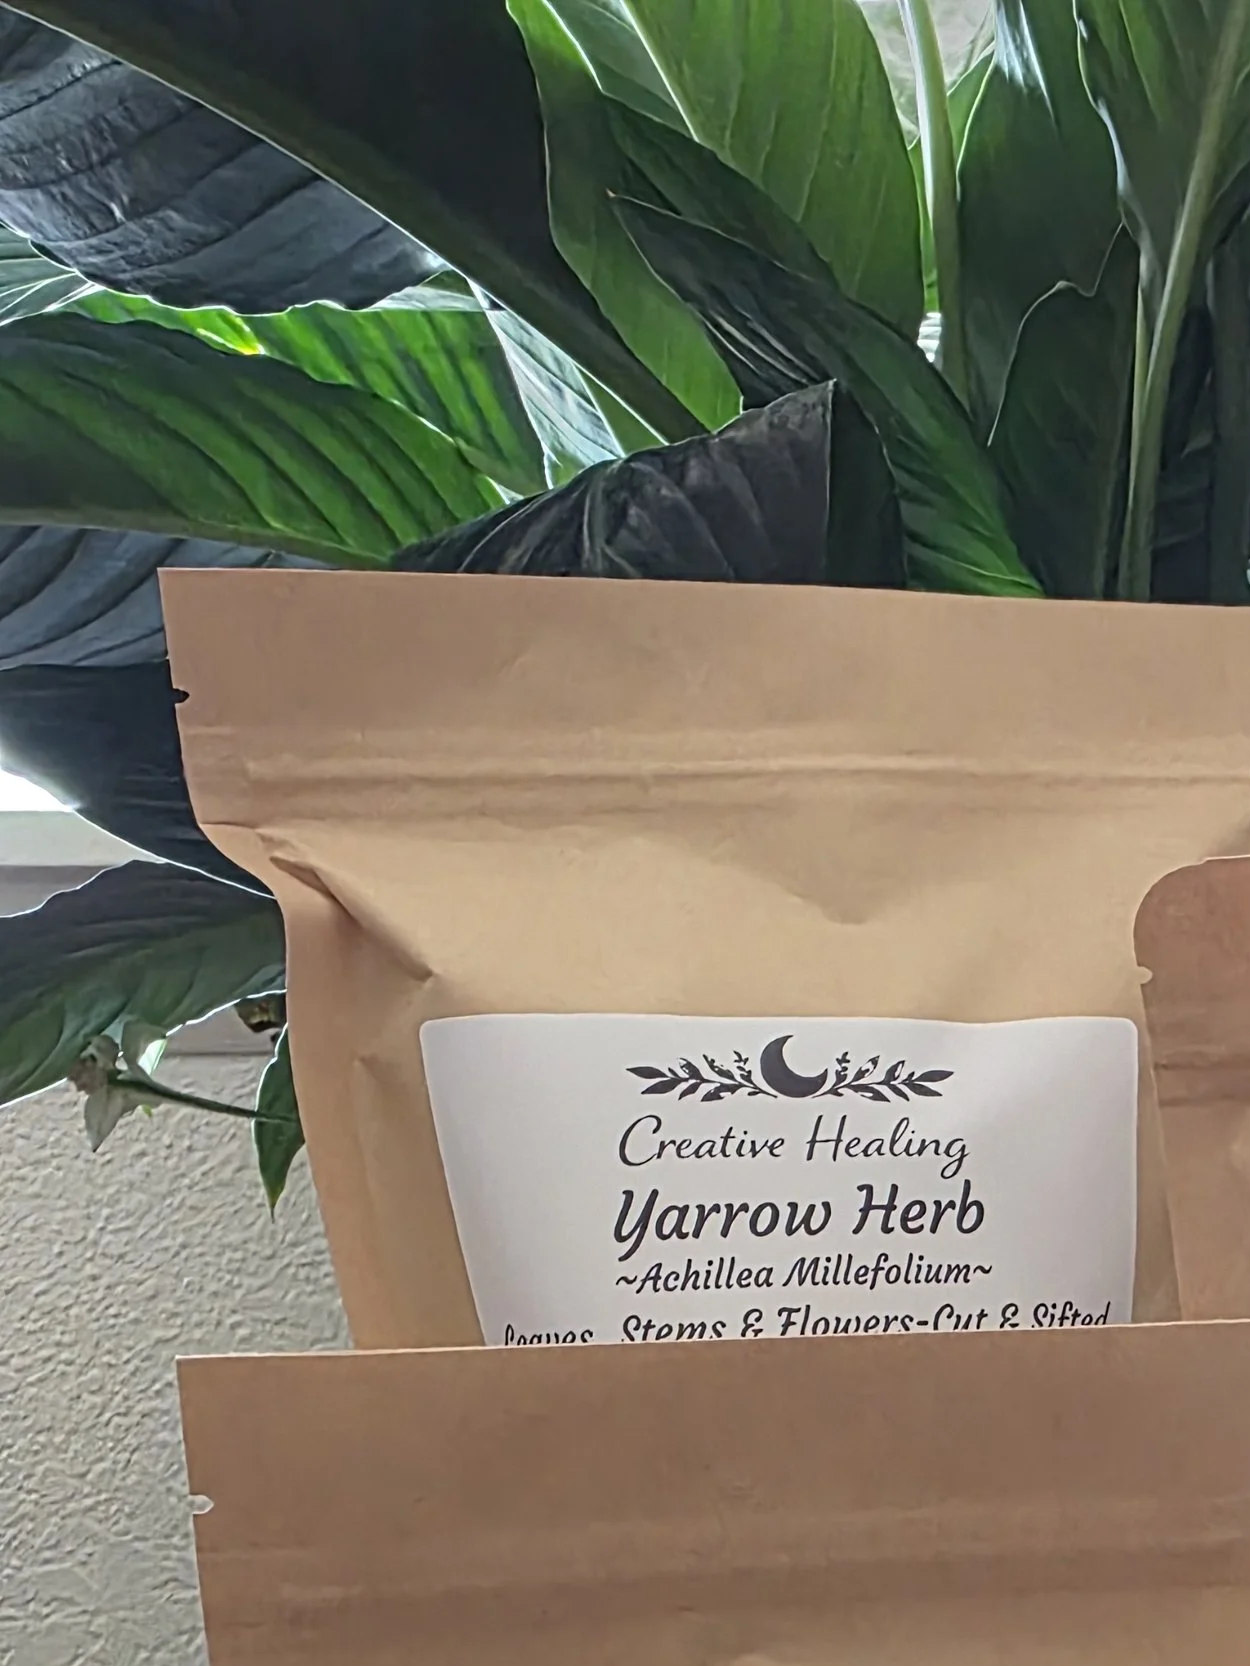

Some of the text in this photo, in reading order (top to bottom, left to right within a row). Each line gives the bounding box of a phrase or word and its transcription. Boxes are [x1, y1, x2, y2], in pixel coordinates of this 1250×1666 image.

[619, 1115, 969, 1179] Creative Healing
[614, 1179, 984, 1266] Yarrow Herb
